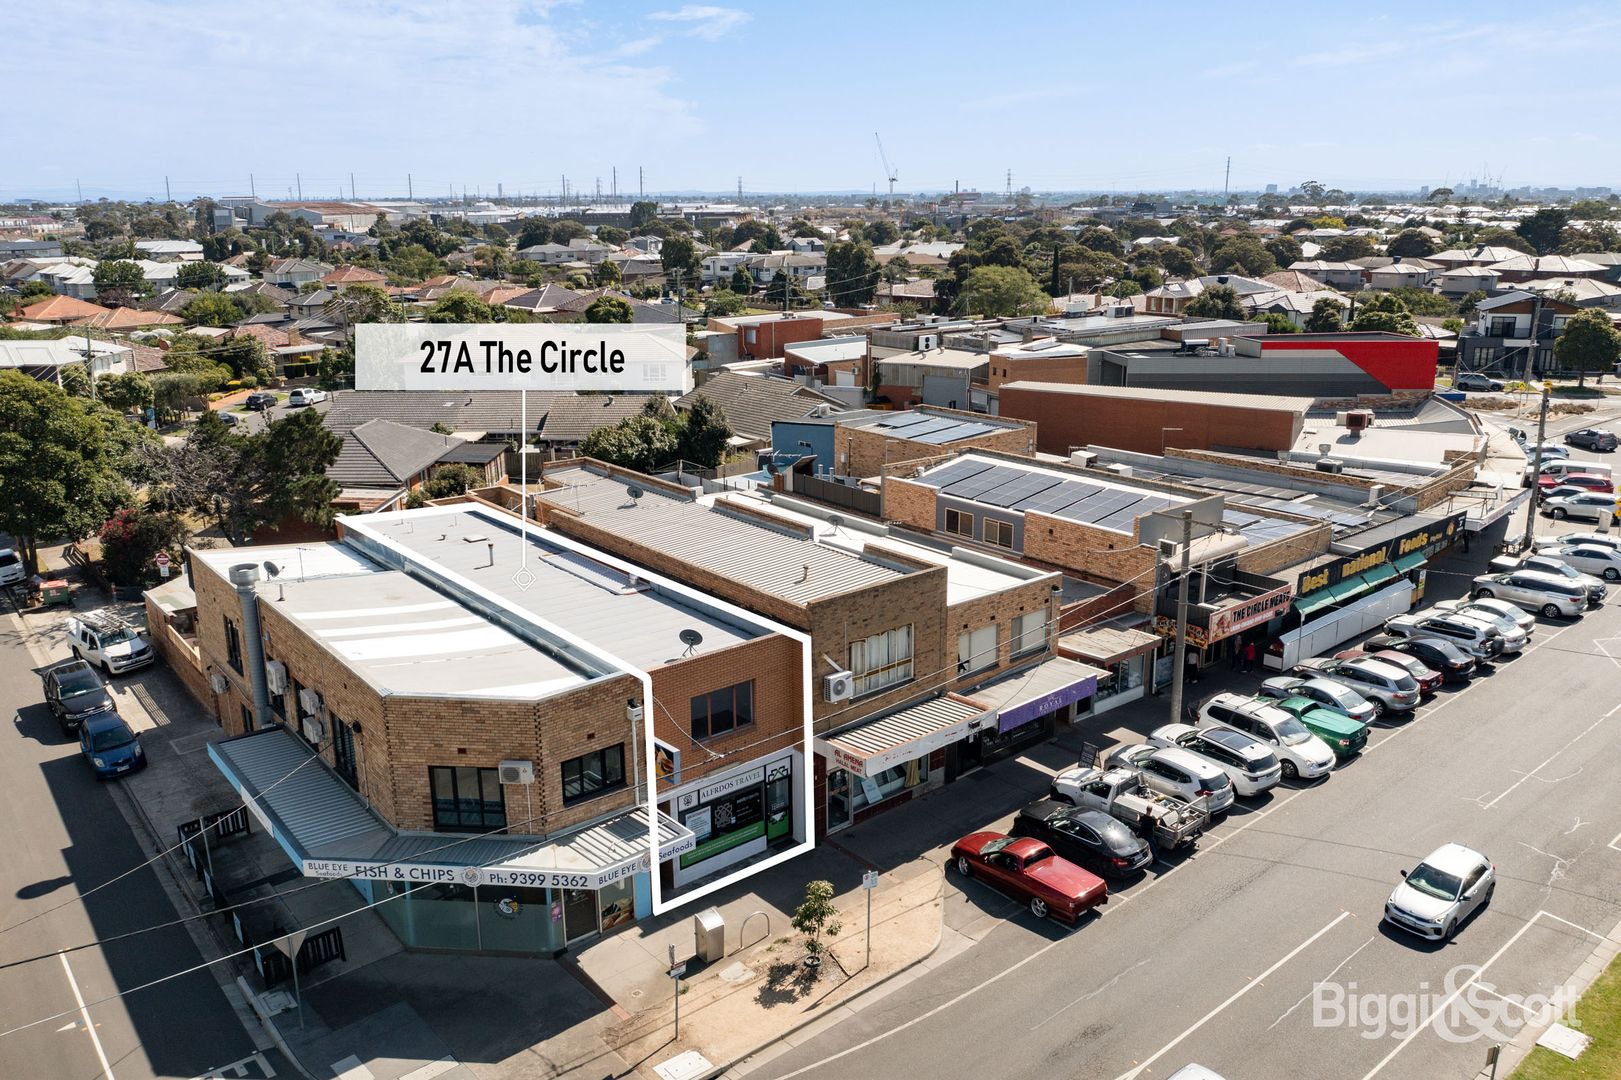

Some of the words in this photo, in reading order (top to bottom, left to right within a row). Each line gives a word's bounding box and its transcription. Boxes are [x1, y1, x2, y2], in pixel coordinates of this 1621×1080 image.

[1301, 568, 1329, 593] Best
[1398, 532, 1429, 555] Foods
[1233, 608, 1246, 622] THE
[1246, 599, 1269, 617] CIRCLE
[834, 749, 842, 758] AL
[835, 758, 850, 769] HALAL
[850, 765, 862, 775] MEAT
[701, 782, 734, 799] ALFRDOS
[735, 771, 760, 786] TRAVEL
[659, 841, 693, 860] Seafoods
[307, 862, 330, 870] BLUE
[332, 863, 348, 871] EYE
[355, 865, 388, 878] FISH
[394, 867, 405, 879] &
[409, 867, 455, 881] CHIPS
[598, 869, 619, 884] BLUE
[621, 862, 637, 875] EYE
[489, 873, 508, 884] Ph:
[509, 872, 546, 886] 9399
[551, 874, 588, 887] 5362
